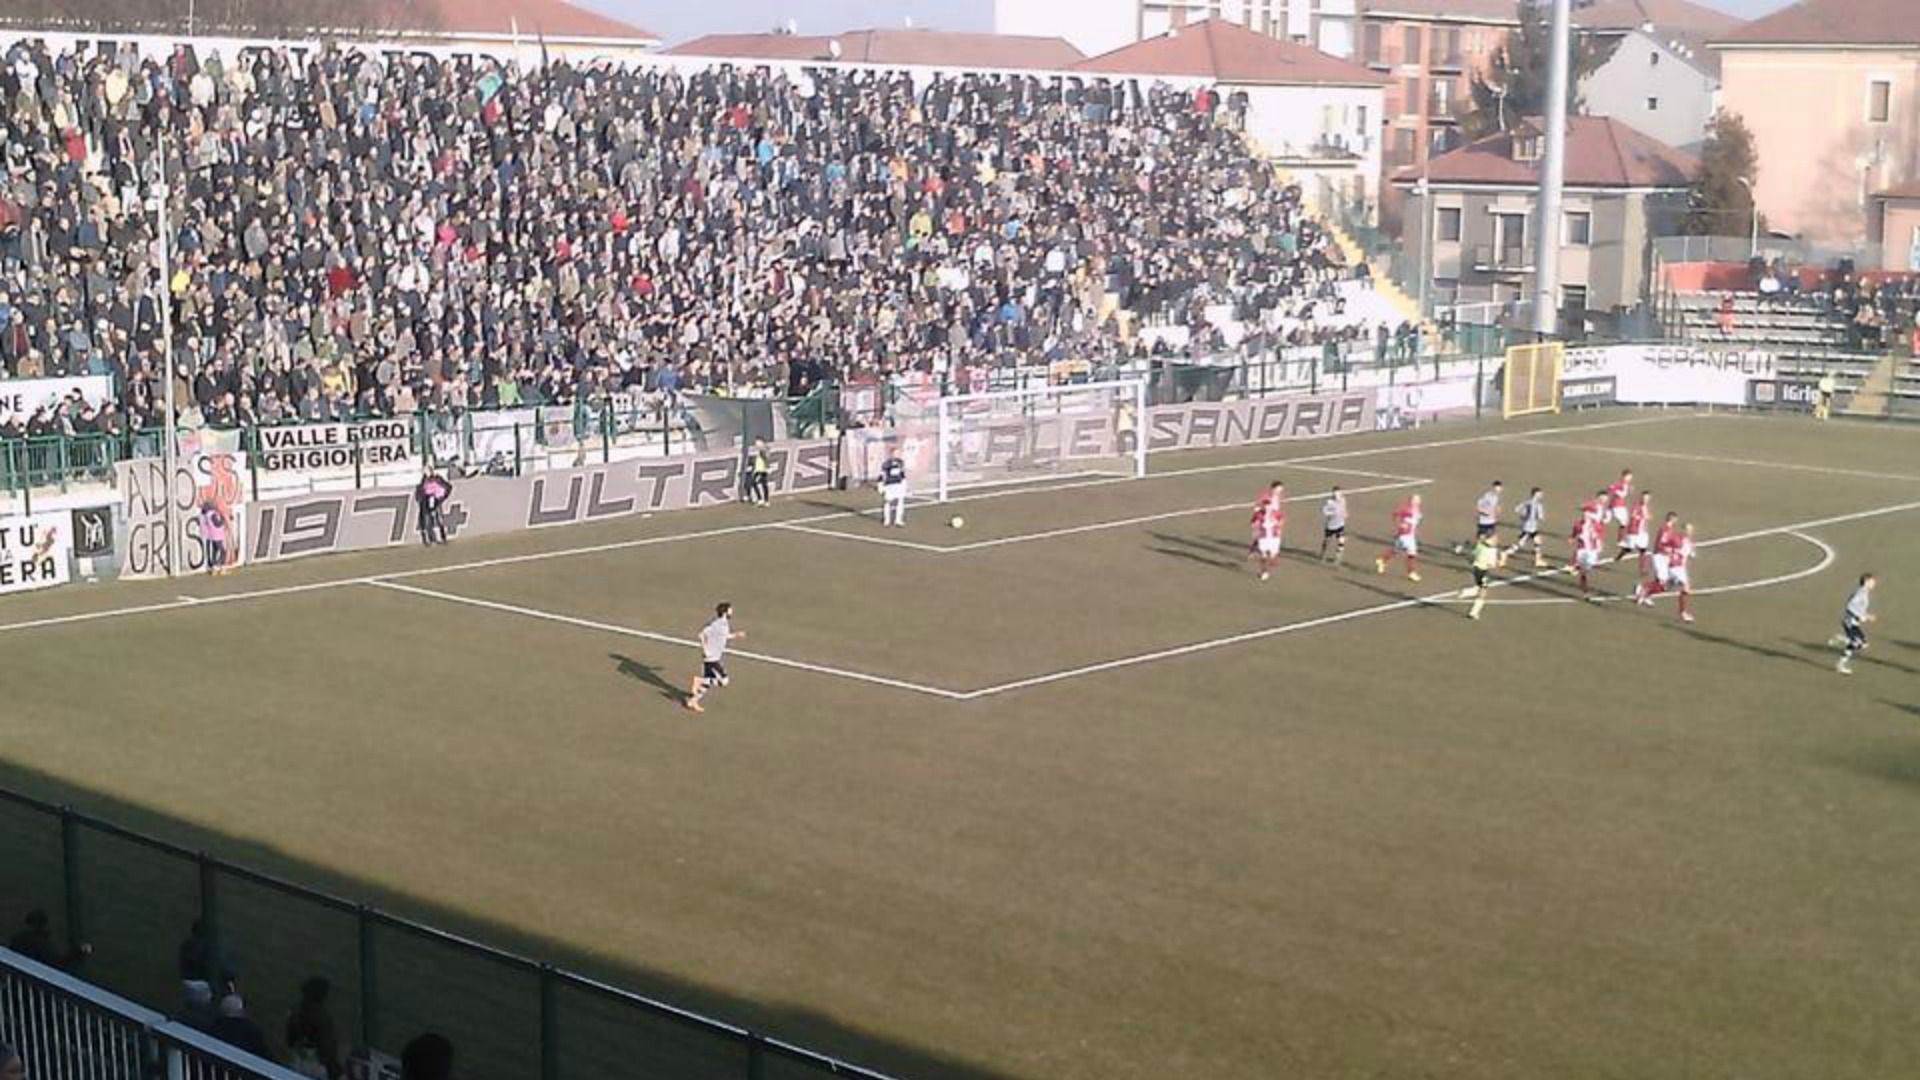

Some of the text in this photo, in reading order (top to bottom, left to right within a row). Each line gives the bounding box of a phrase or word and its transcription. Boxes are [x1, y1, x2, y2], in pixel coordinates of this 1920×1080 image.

[265, 422, 405, 448] VALLE ERRO
[984, 397, 1366, 463] ALESANDRIA
[265, 444, 408, 471] GRIGIONERA
